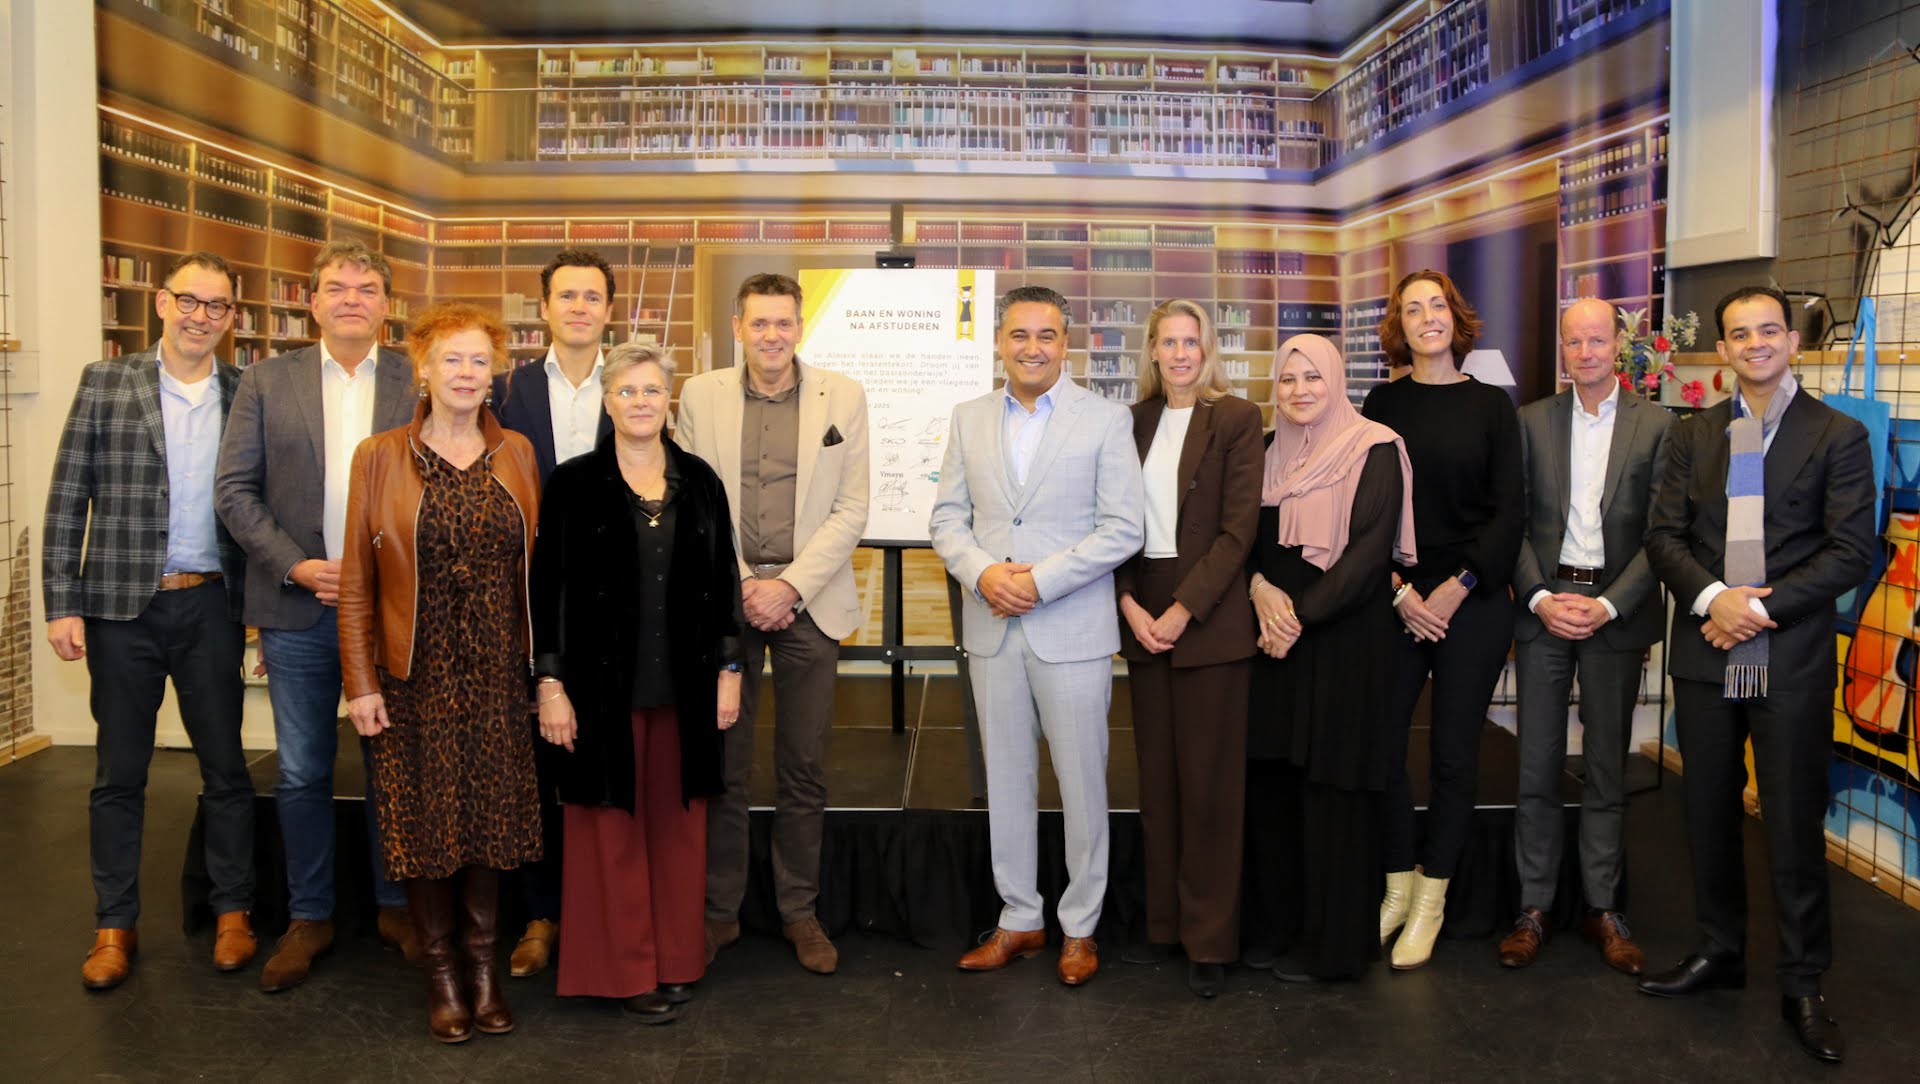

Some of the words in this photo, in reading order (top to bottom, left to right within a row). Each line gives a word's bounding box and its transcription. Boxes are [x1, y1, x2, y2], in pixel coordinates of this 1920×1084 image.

[845, 309, 876, 318] BAAN
[879, 309, 893, 318] EN
[897, 310, 941, 318] WONING
[849, 322, 865, 330] NA
[868, 322, 940, 331] AFSTUDEREN
